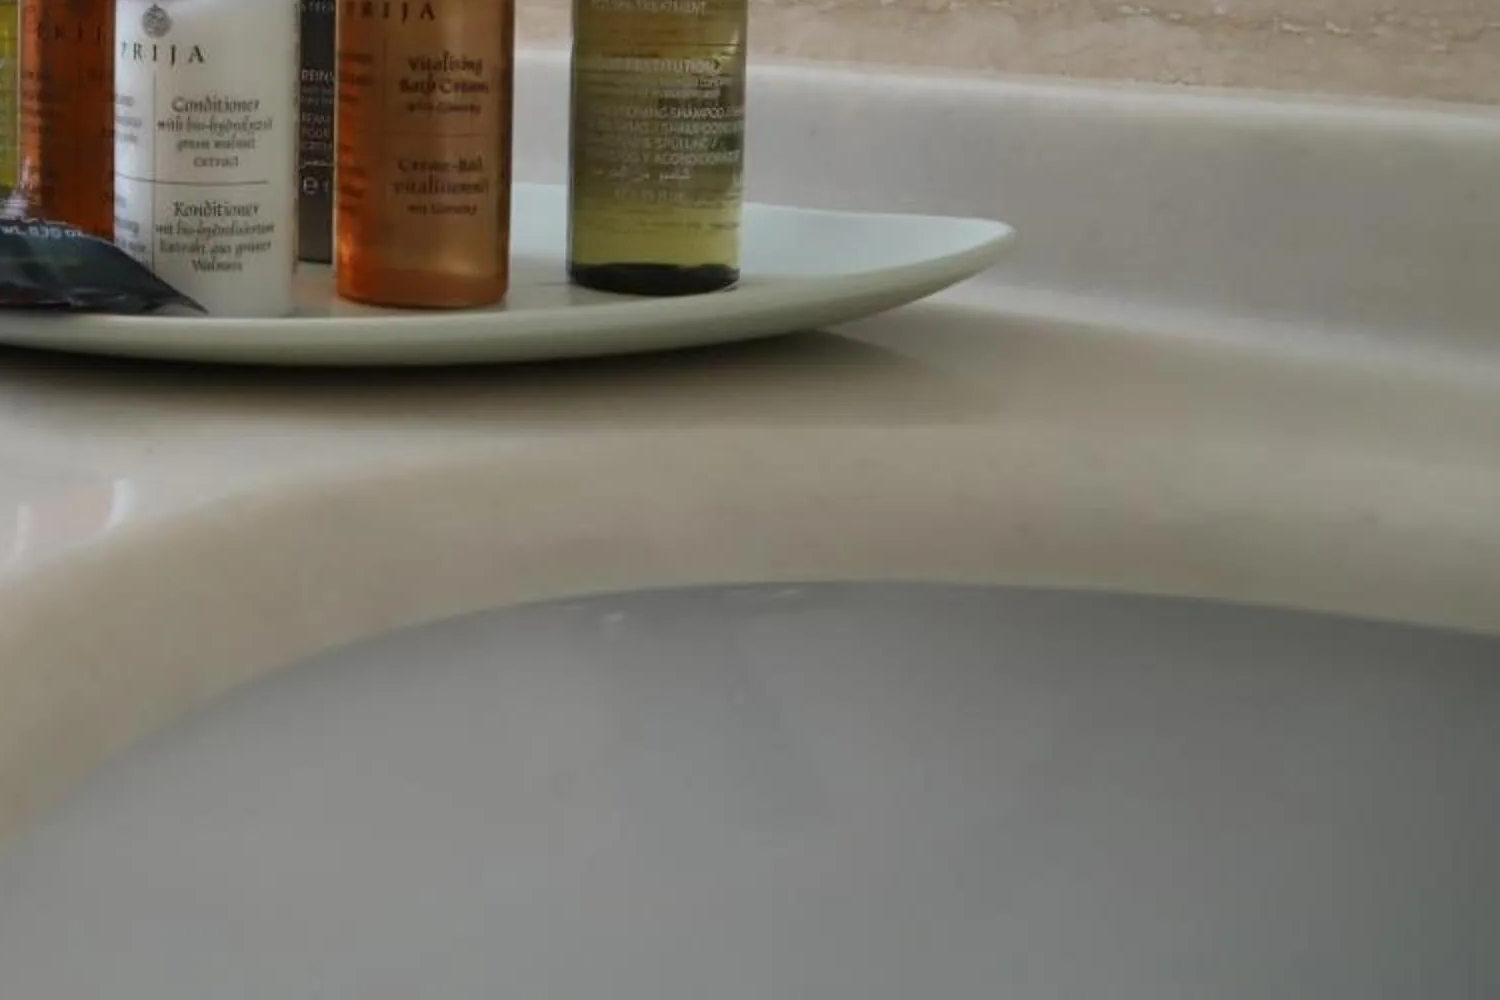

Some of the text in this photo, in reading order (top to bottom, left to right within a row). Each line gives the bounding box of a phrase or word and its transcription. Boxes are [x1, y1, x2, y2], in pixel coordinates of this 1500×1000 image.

[171, 95, 260, 113] Conditioner
[157, 116, 183, 132] with
[193, 156, 239, 168] extract
[173, 200, 260, 217] Konditioner
